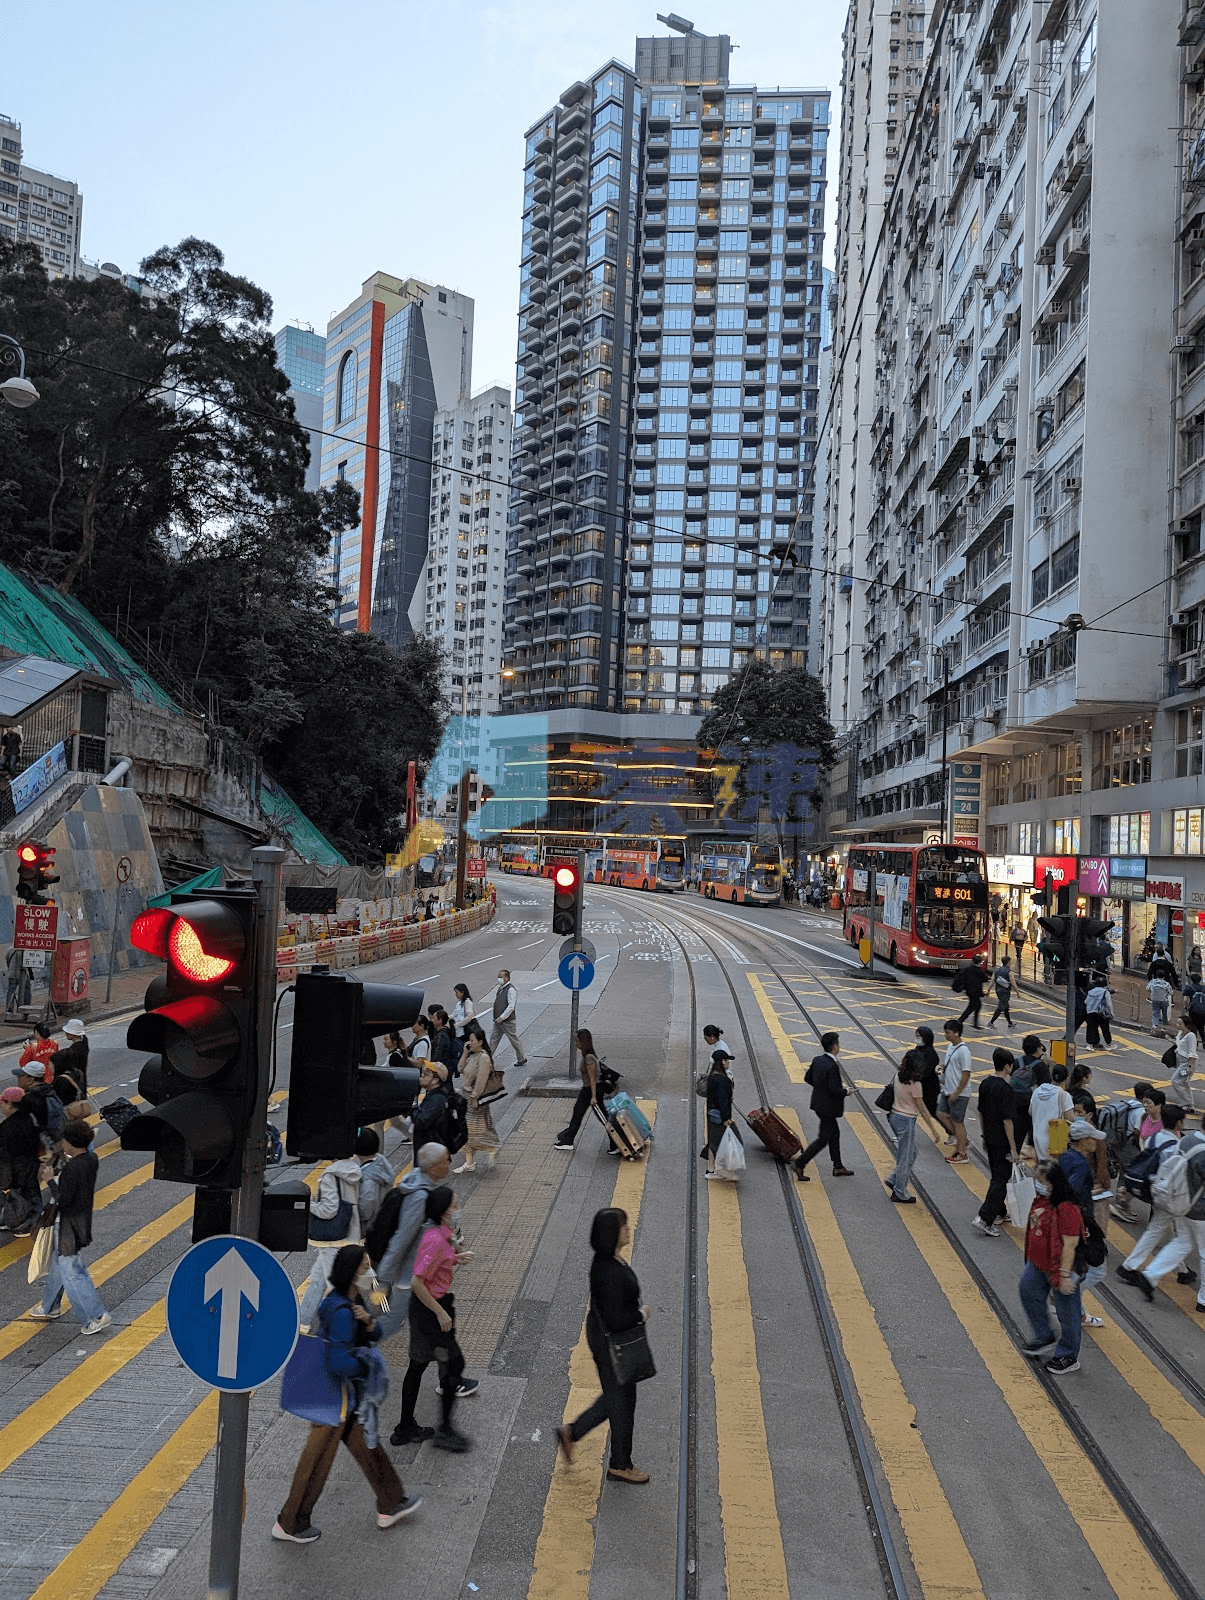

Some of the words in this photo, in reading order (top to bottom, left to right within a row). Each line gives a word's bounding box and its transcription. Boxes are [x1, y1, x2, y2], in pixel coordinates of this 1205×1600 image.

[961, 802, 972, 812] 24
[1080, 860, 1098, 870] DAISO
[954, 888, 972, 901] 601
[23, 908, 51, 918] SLOW
[24, 918, 49, 931] 慢駛
[24, 958, 44, 966] 五十米
